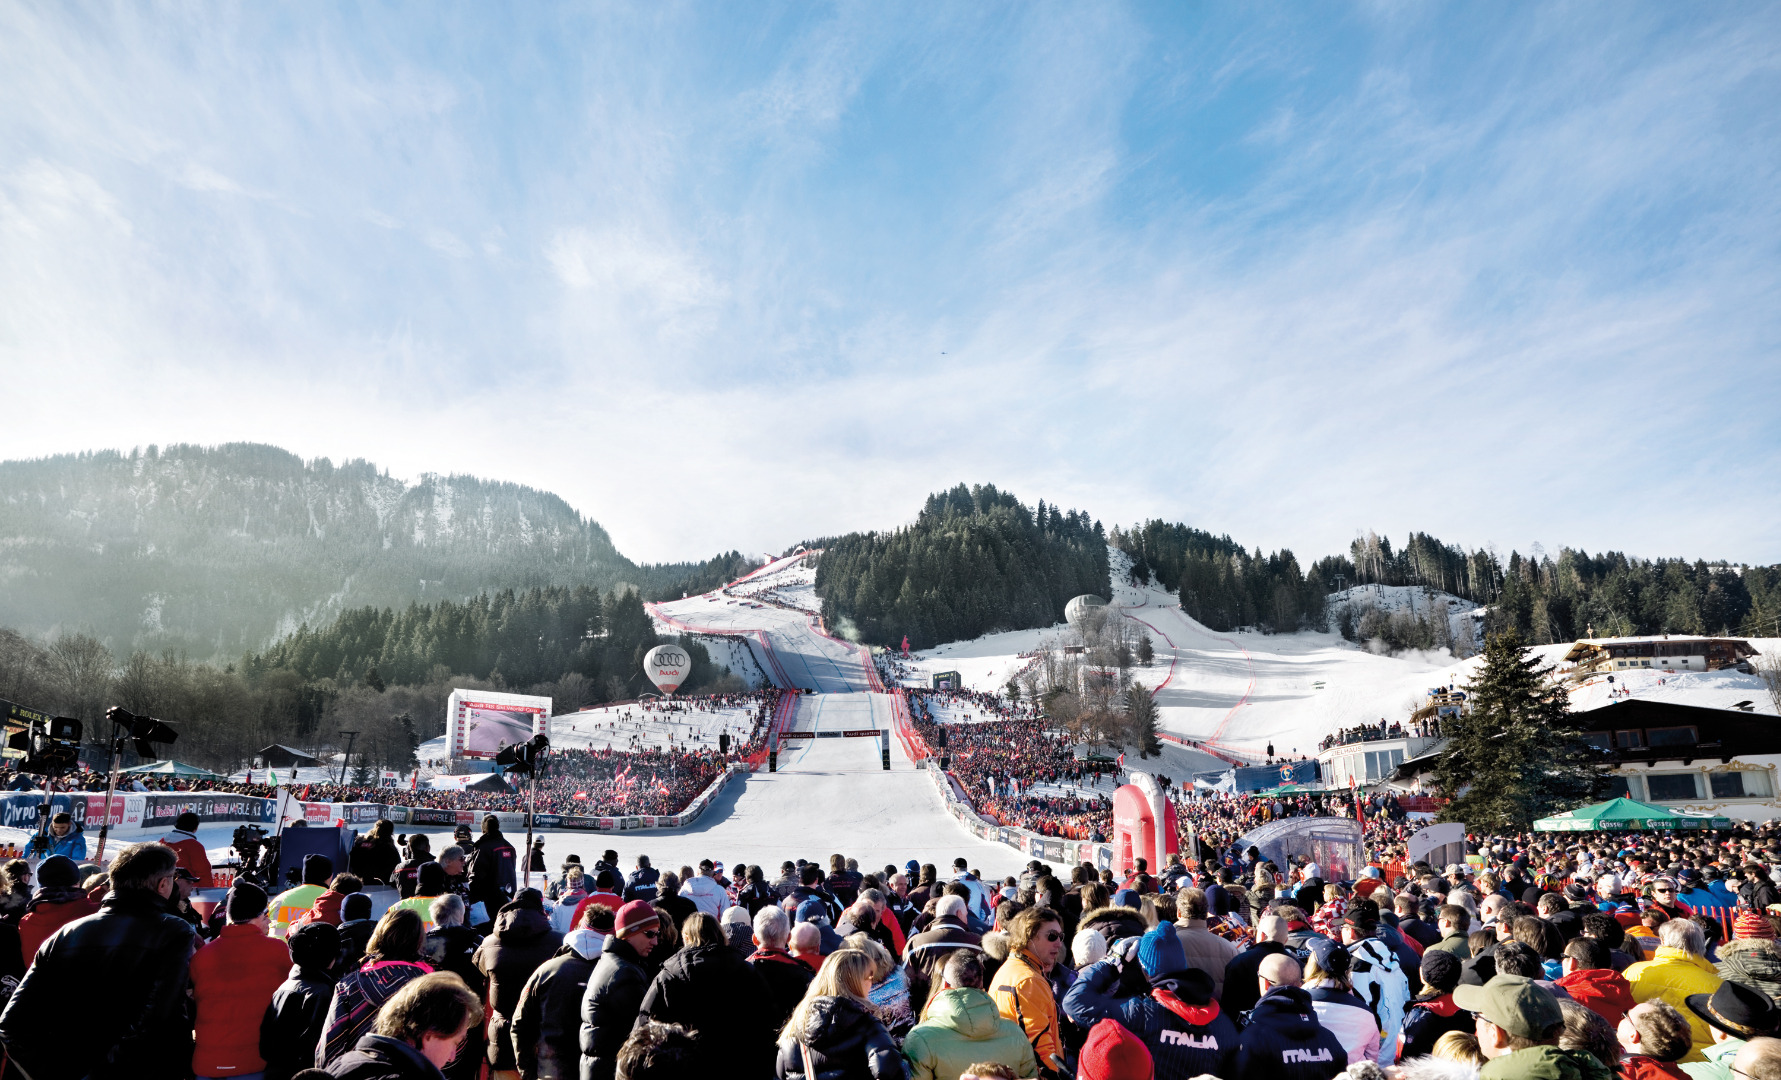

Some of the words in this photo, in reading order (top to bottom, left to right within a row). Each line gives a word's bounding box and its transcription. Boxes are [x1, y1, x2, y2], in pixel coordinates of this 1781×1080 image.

[19, 708, 42, 721] ROLEX
[1331, 745, 1362, 756] ZIELHAUS
[382, 778, 397, 788] WC
[127, 815, 138, 823] Audi
[1160, 1029, 1219, 1050] ITALIA
[1282, 1048, 1333, 1063] ITALIA
